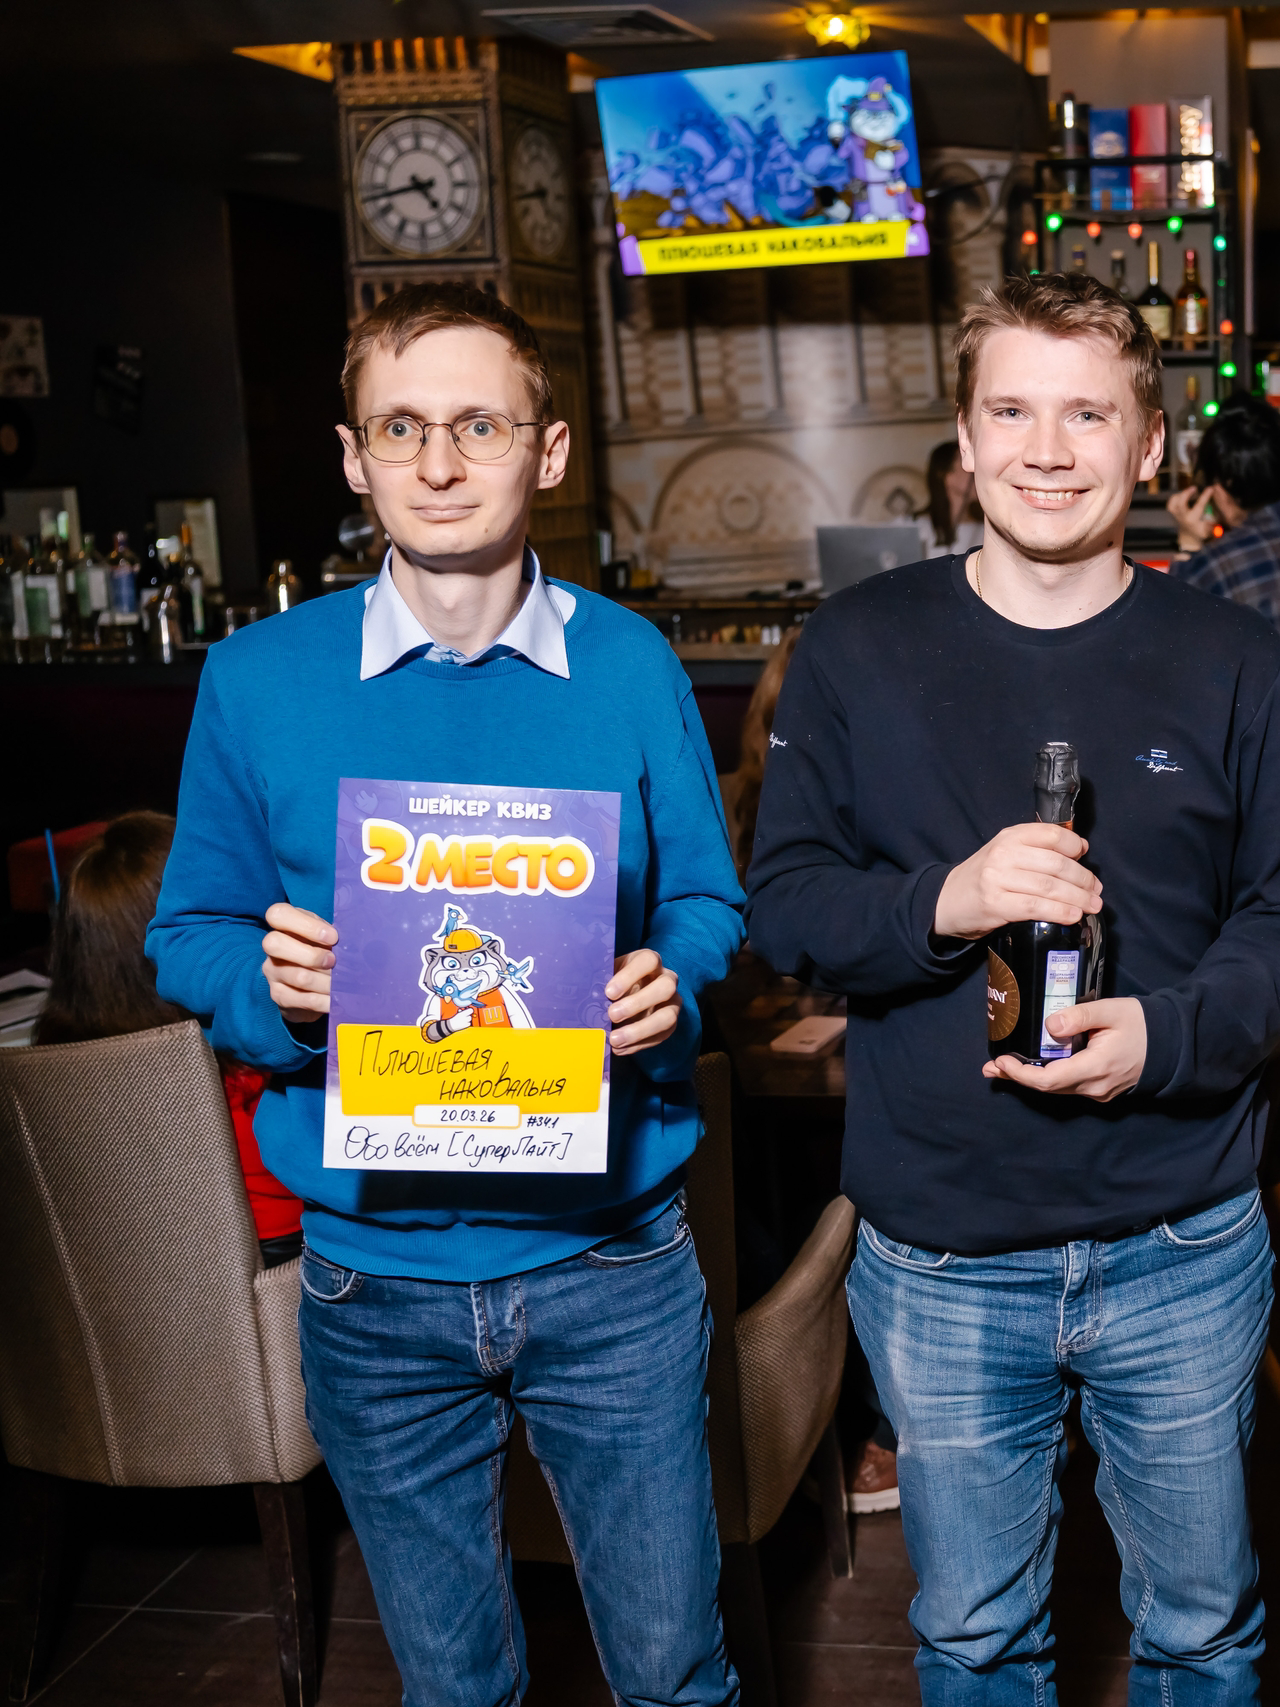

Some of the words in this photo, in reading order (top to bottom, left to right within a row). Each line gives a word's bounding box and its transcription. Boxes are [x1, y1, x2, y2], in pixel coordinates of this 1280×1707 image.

[408, 793, 491, 817] ШЕЙКЕР
[497, 801, 553, 821] КВИЗ
[365, 822, 410, 888] 2
[413, 836, 592, 894] МЕСТО
[440, 1109, 496, 1124] 20.03.26
